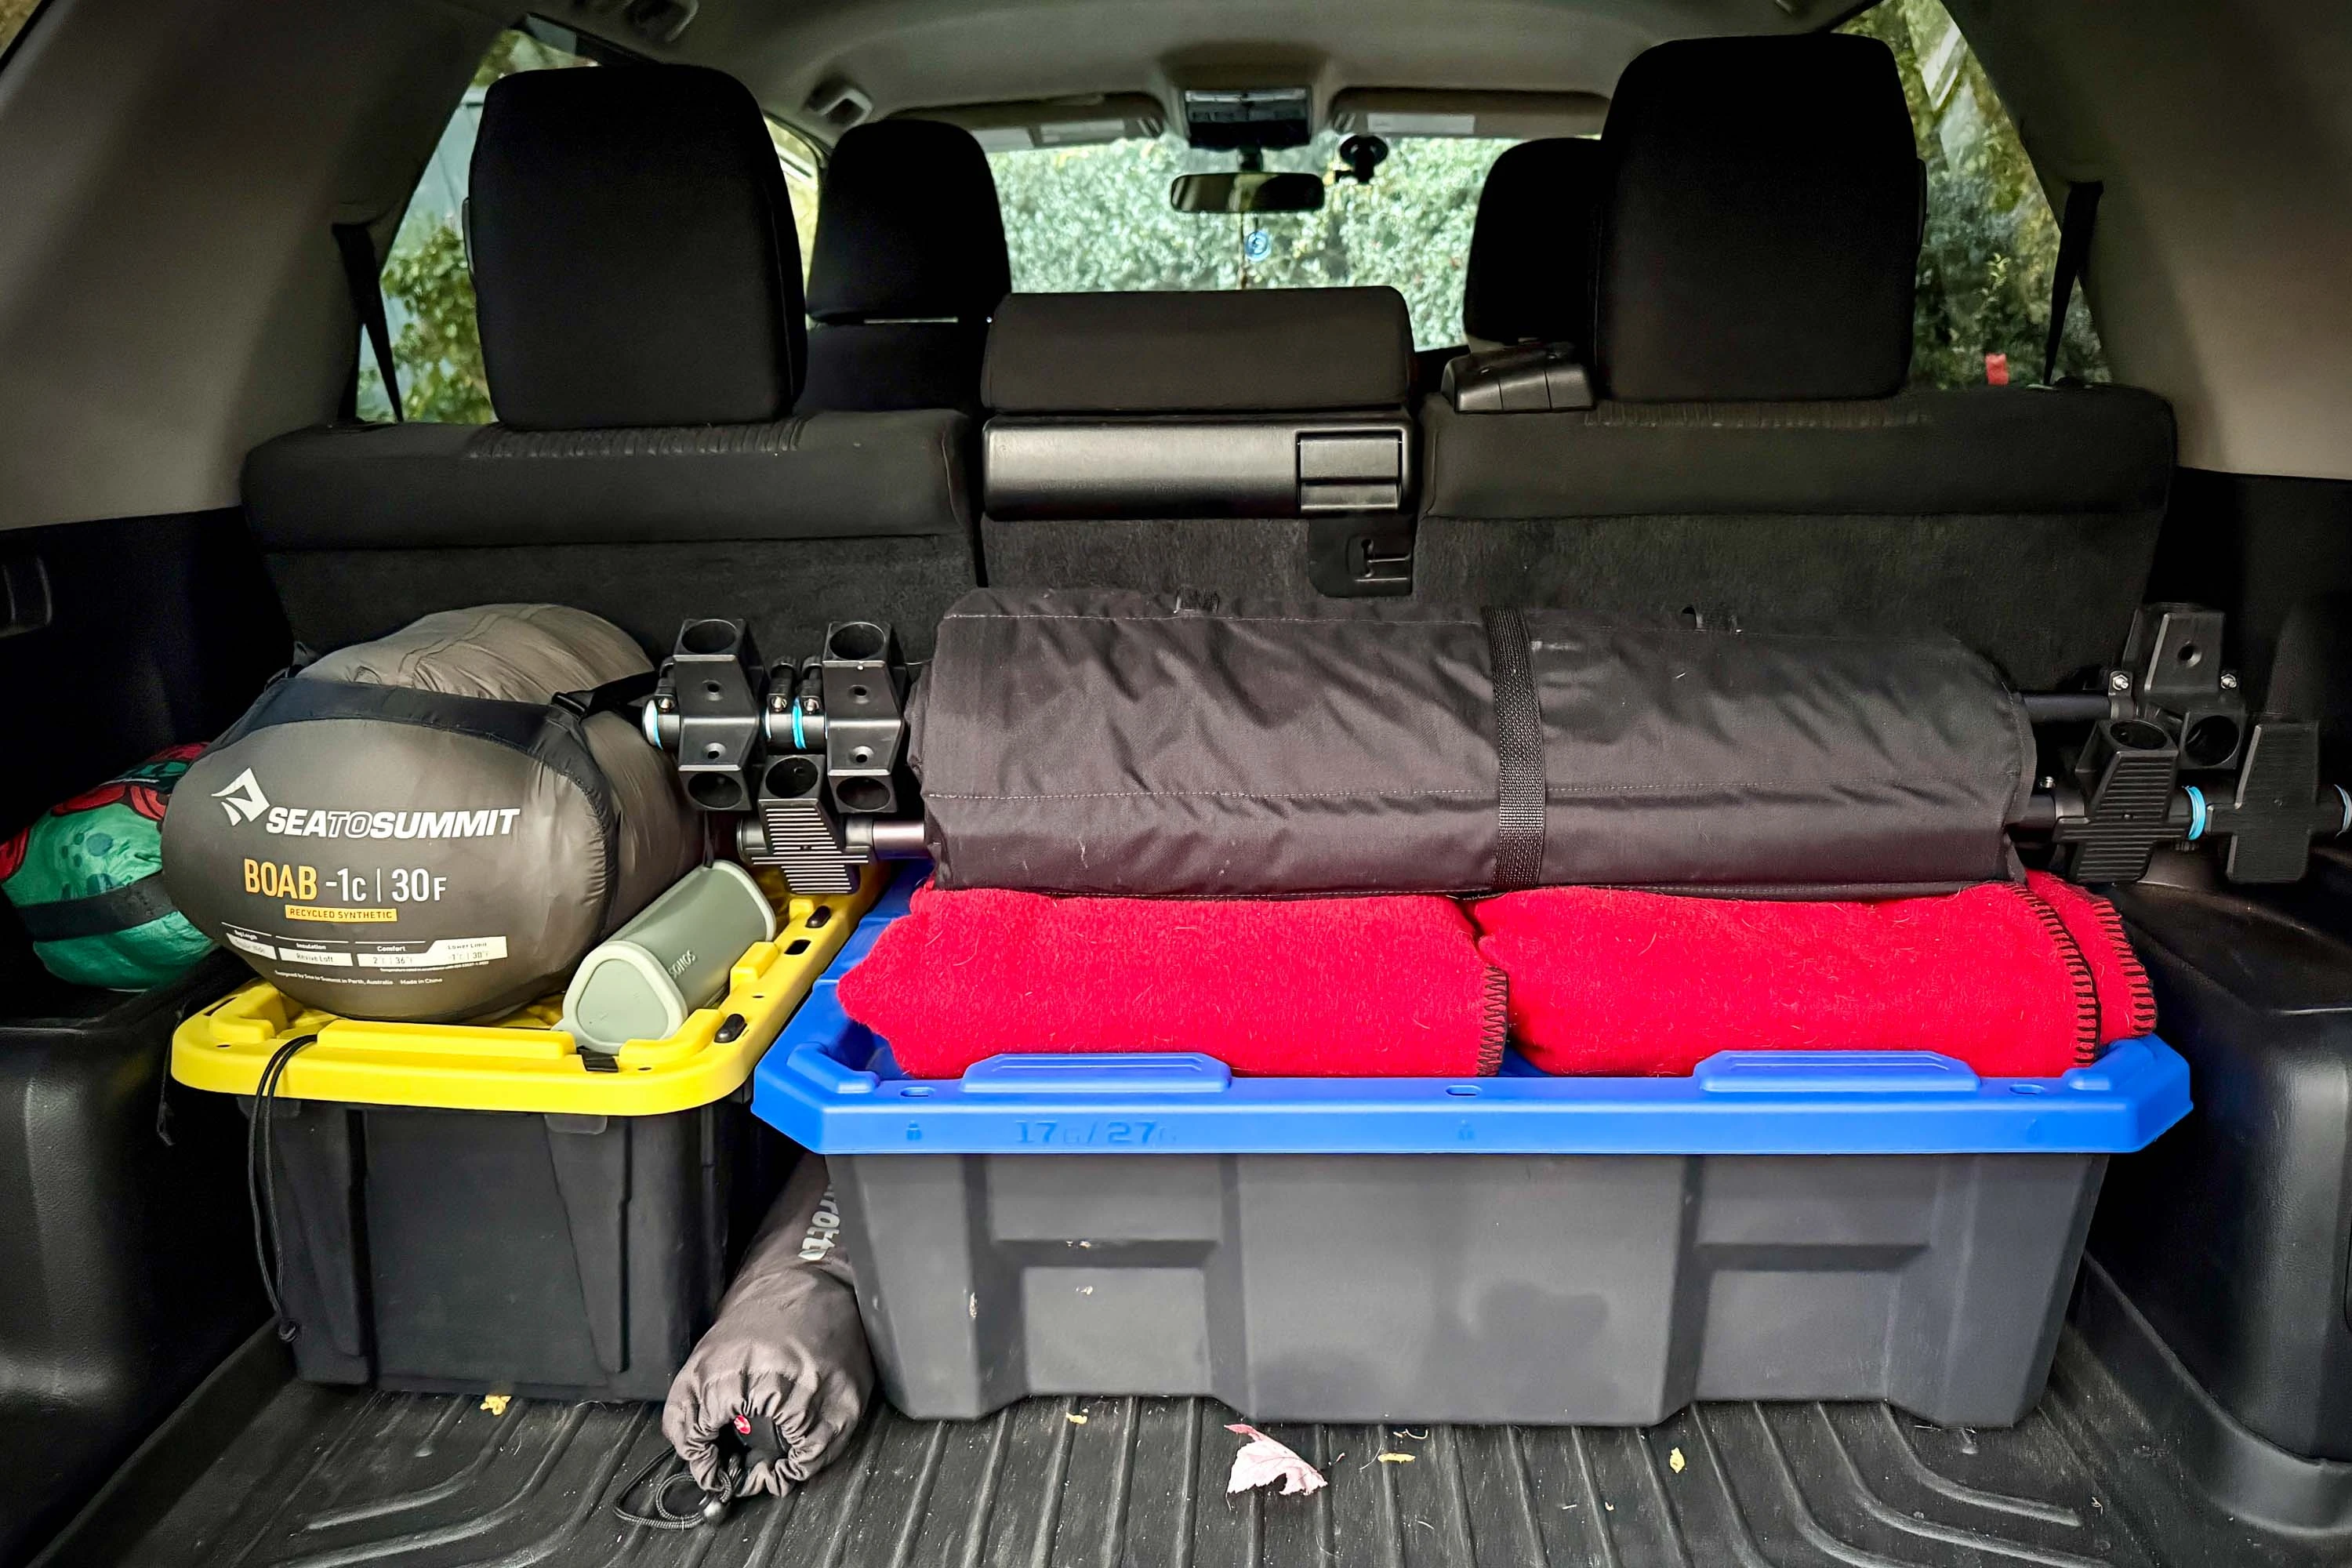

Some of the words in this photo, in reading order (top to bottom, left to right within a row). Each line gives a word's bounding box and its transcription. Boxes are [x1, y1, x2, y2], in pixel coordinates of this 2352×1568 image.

[244, 858, 318, 901] BOAB
[289, 908, 336, 920] RECYCLED
[337, 911, 393, 920] SYNTHETIC
